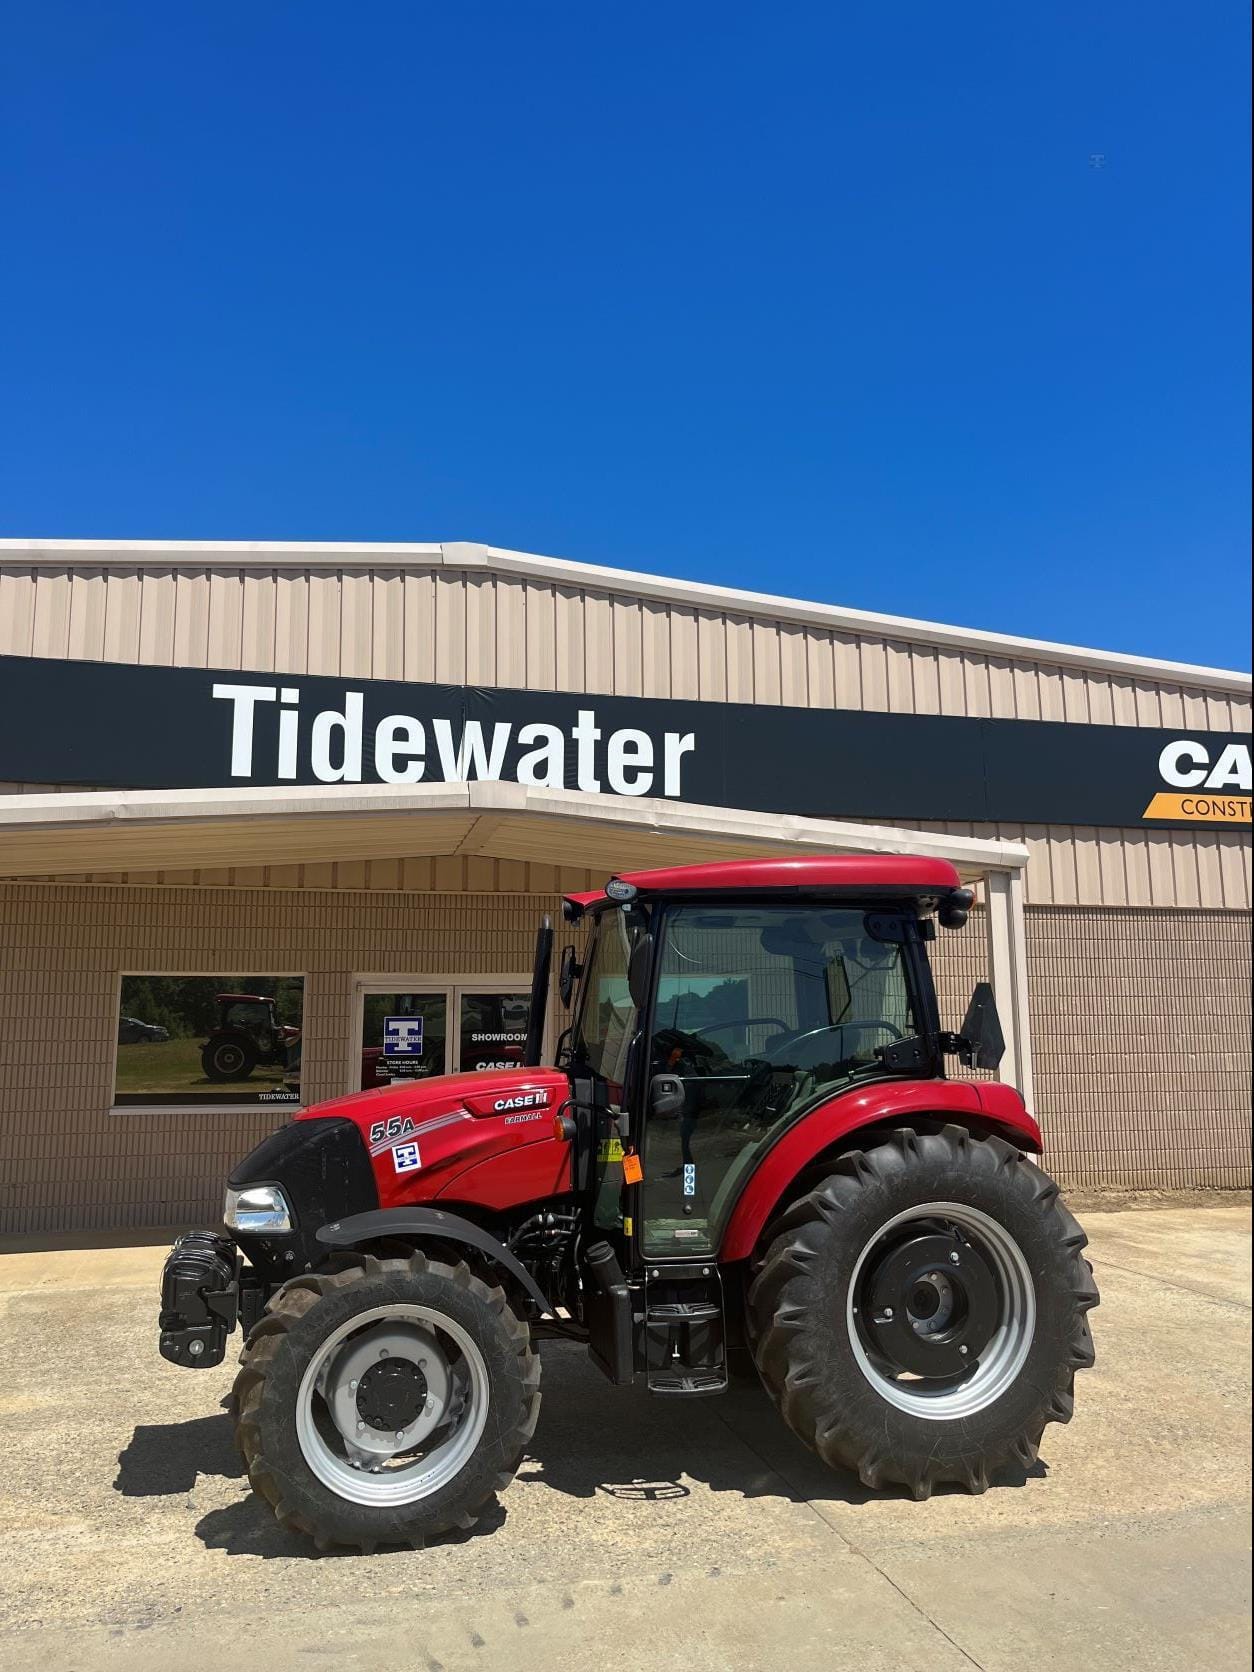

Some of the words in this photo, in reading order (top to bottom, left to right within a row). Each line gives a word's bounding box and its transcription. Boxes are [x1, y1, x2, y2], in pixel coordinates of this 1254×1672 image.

[212, 684, 695, 797] Tidewater
[1182, 799, 1252, 817] CONST
[494, 1095, 534, 1110] CASE
